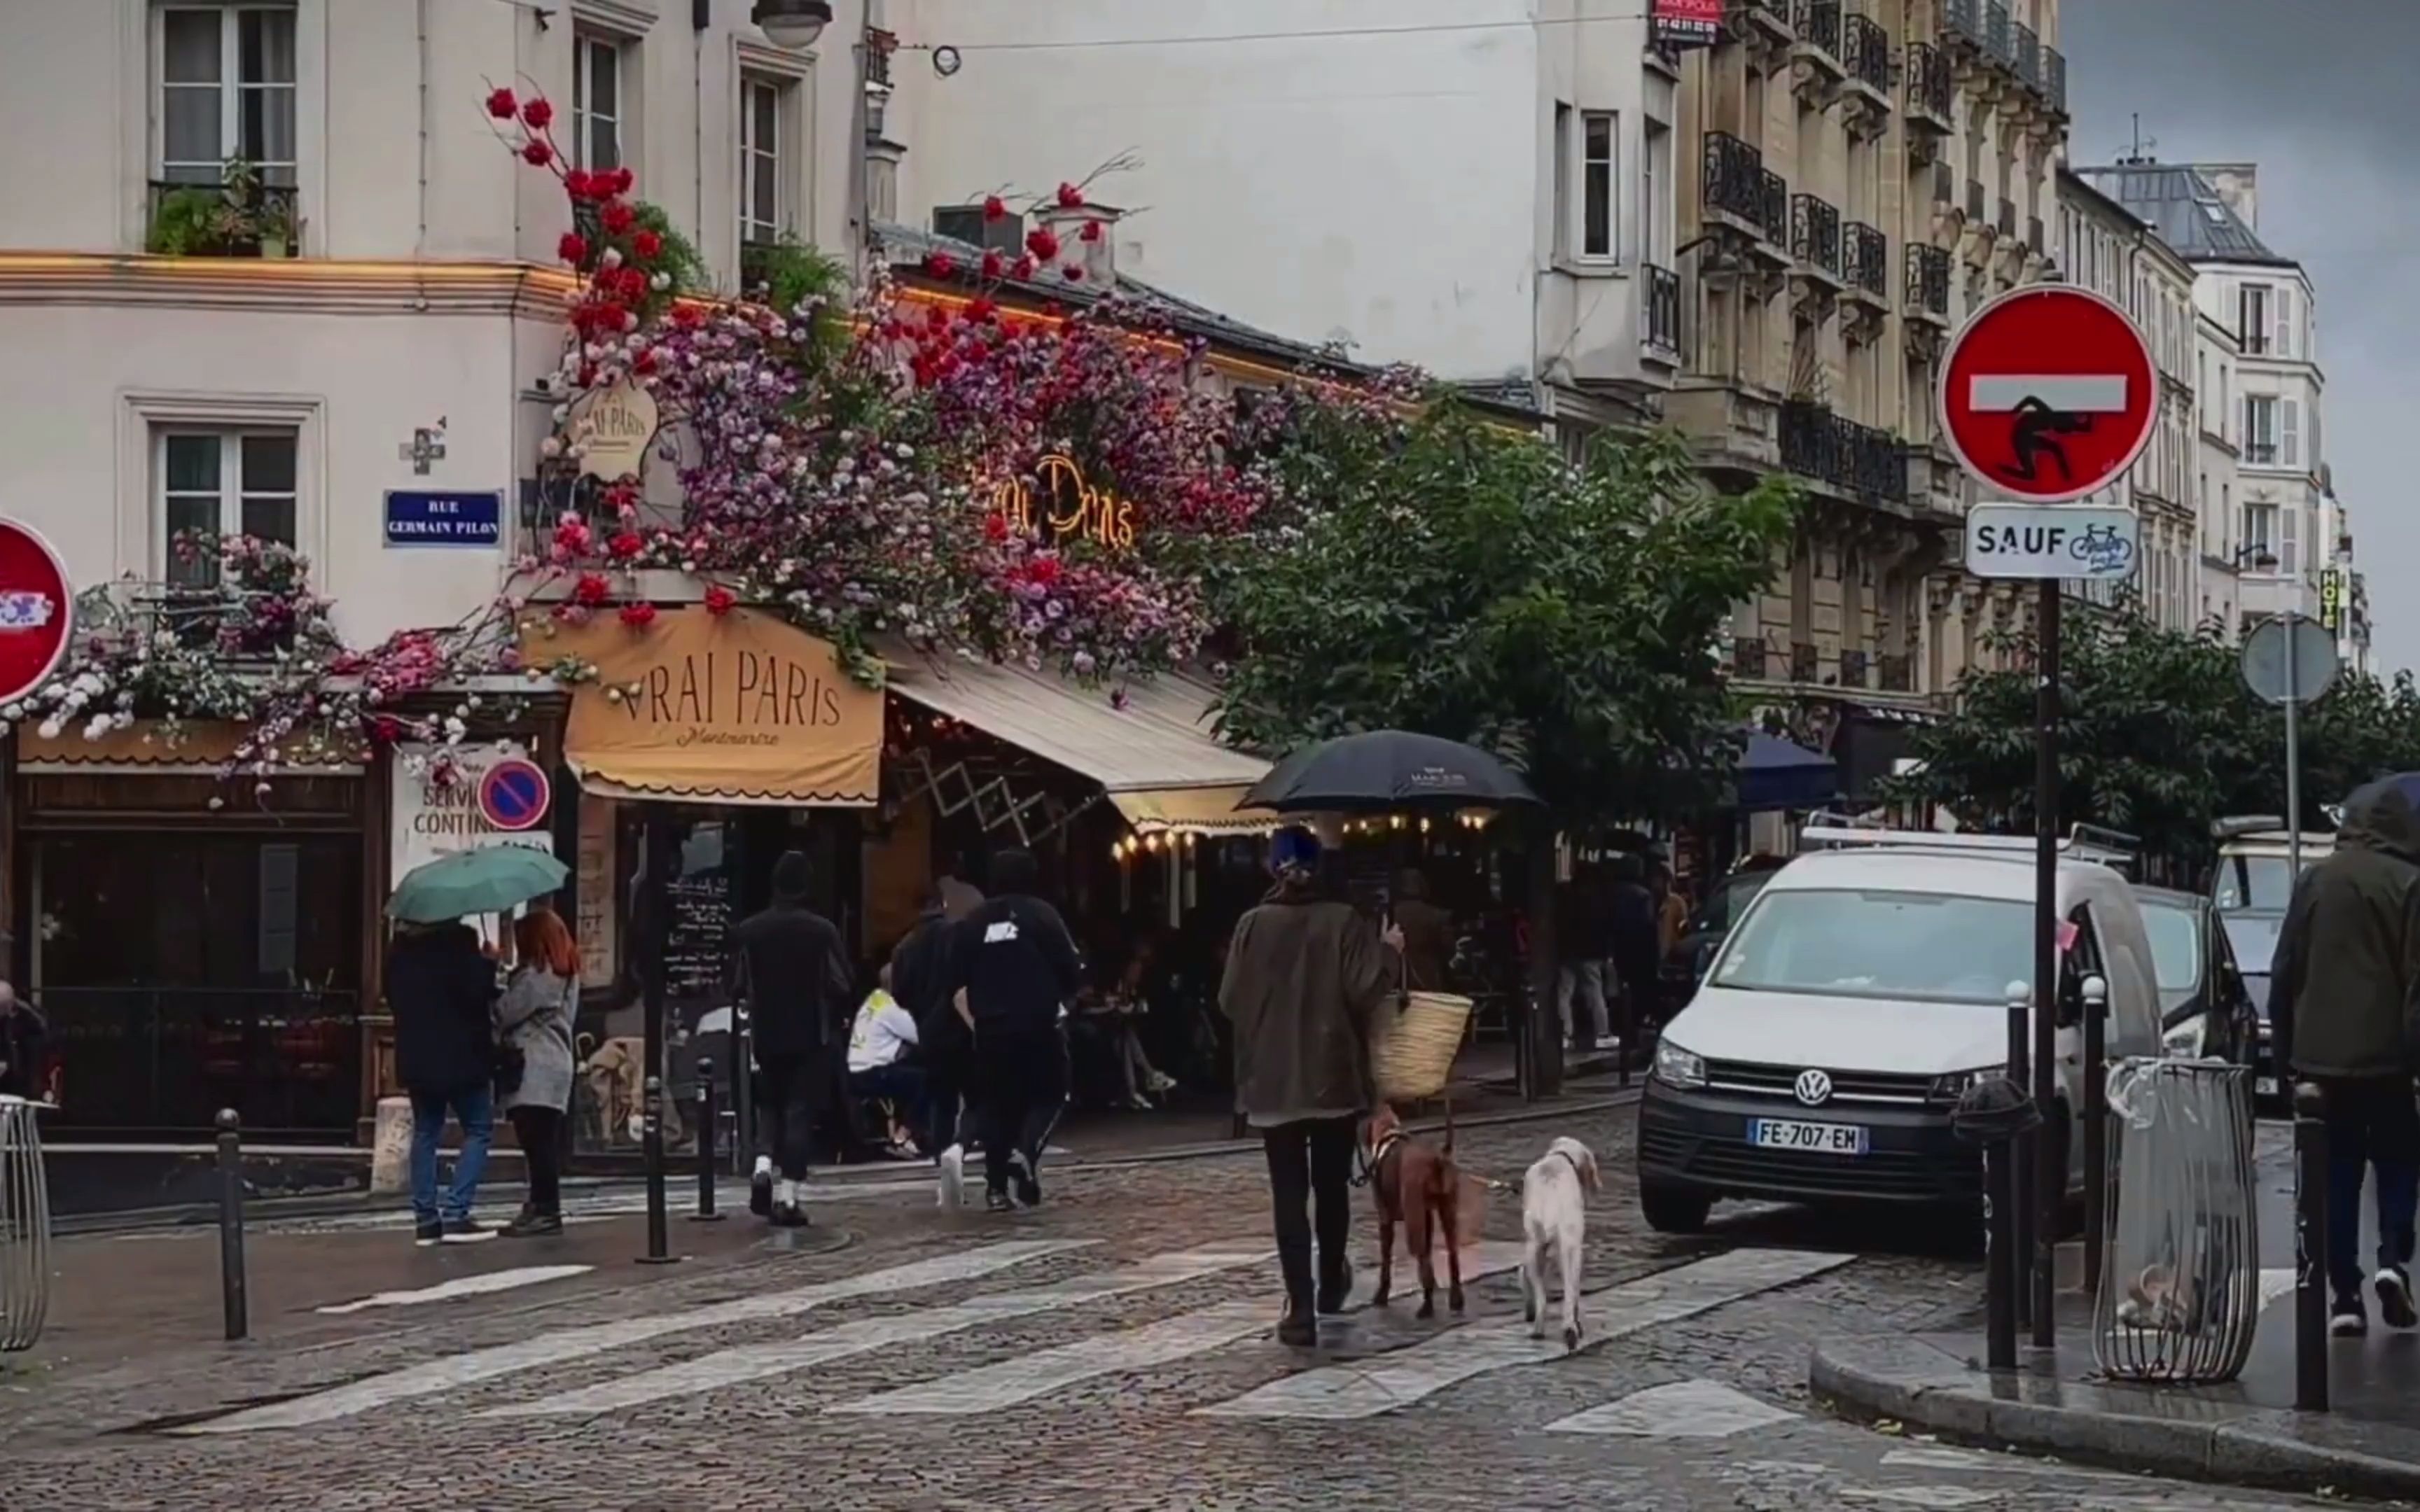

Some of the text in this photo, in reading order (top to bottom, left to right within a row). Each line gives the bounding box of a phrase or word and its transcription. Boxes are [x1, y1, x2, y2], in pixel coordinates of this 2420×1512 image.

[428, 500, 459, 513] RUE
[388, 520, 498, 535] GERMAIN PILON
[1976, 525, 2066, 554] SAUF
[736, 649, 840, 727] PARIS
[676, 728, 779, 748] Montmartre
[423, 784, 476, 807] SERVI
